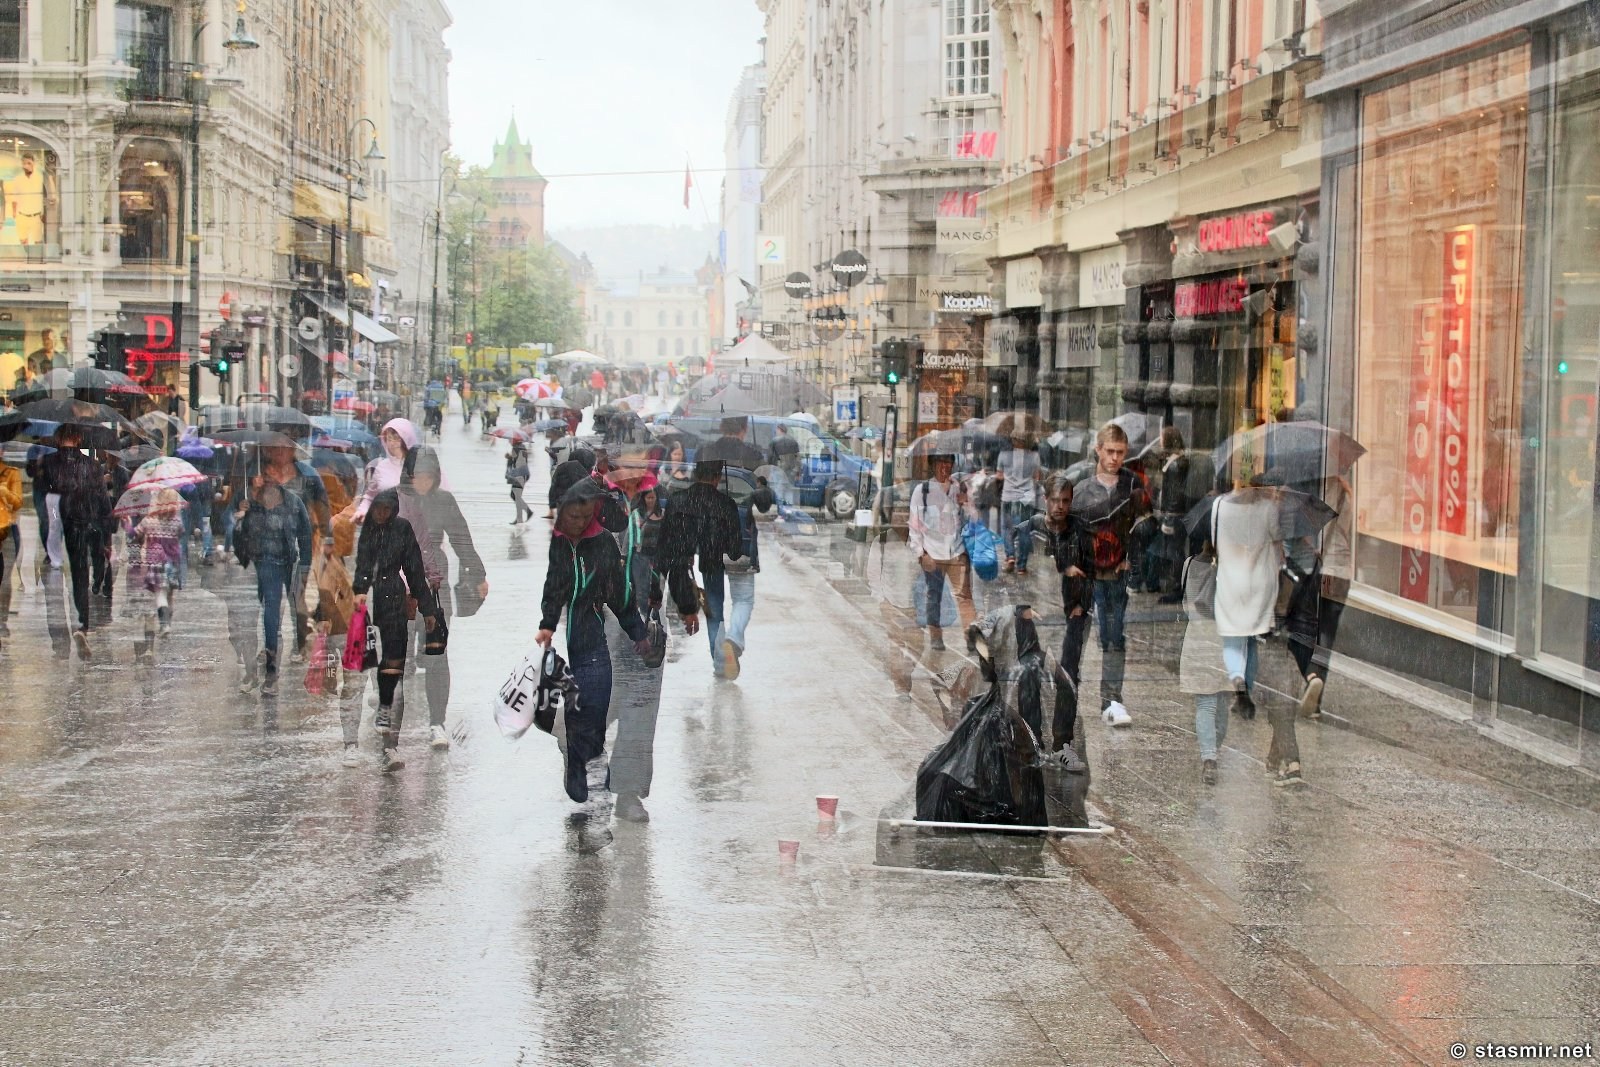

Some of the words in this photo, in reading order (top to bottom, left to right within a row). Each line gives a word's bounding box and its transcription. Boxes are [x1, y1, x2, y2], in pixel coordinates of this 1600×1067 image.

[940, 231, 993, 241] MANGO
[919, 289, 972, 298] MANGO
[1092, 262, 1120, 290] MANGO
[1451, 234, 1468, 305] UP
[144, 315, 175, 350] D
[993, 330, 1015, 352] MANGO
[1067, 324, 1096, 352] MANGO
[1419, 307, 1436, 376] UP
[1447, 317, 1464, 388] TO
[1415, 388, 1430, 459] TO
[1445, 402, 1461, 518] 70%
[1408, 473, 1426, 586] 70%
